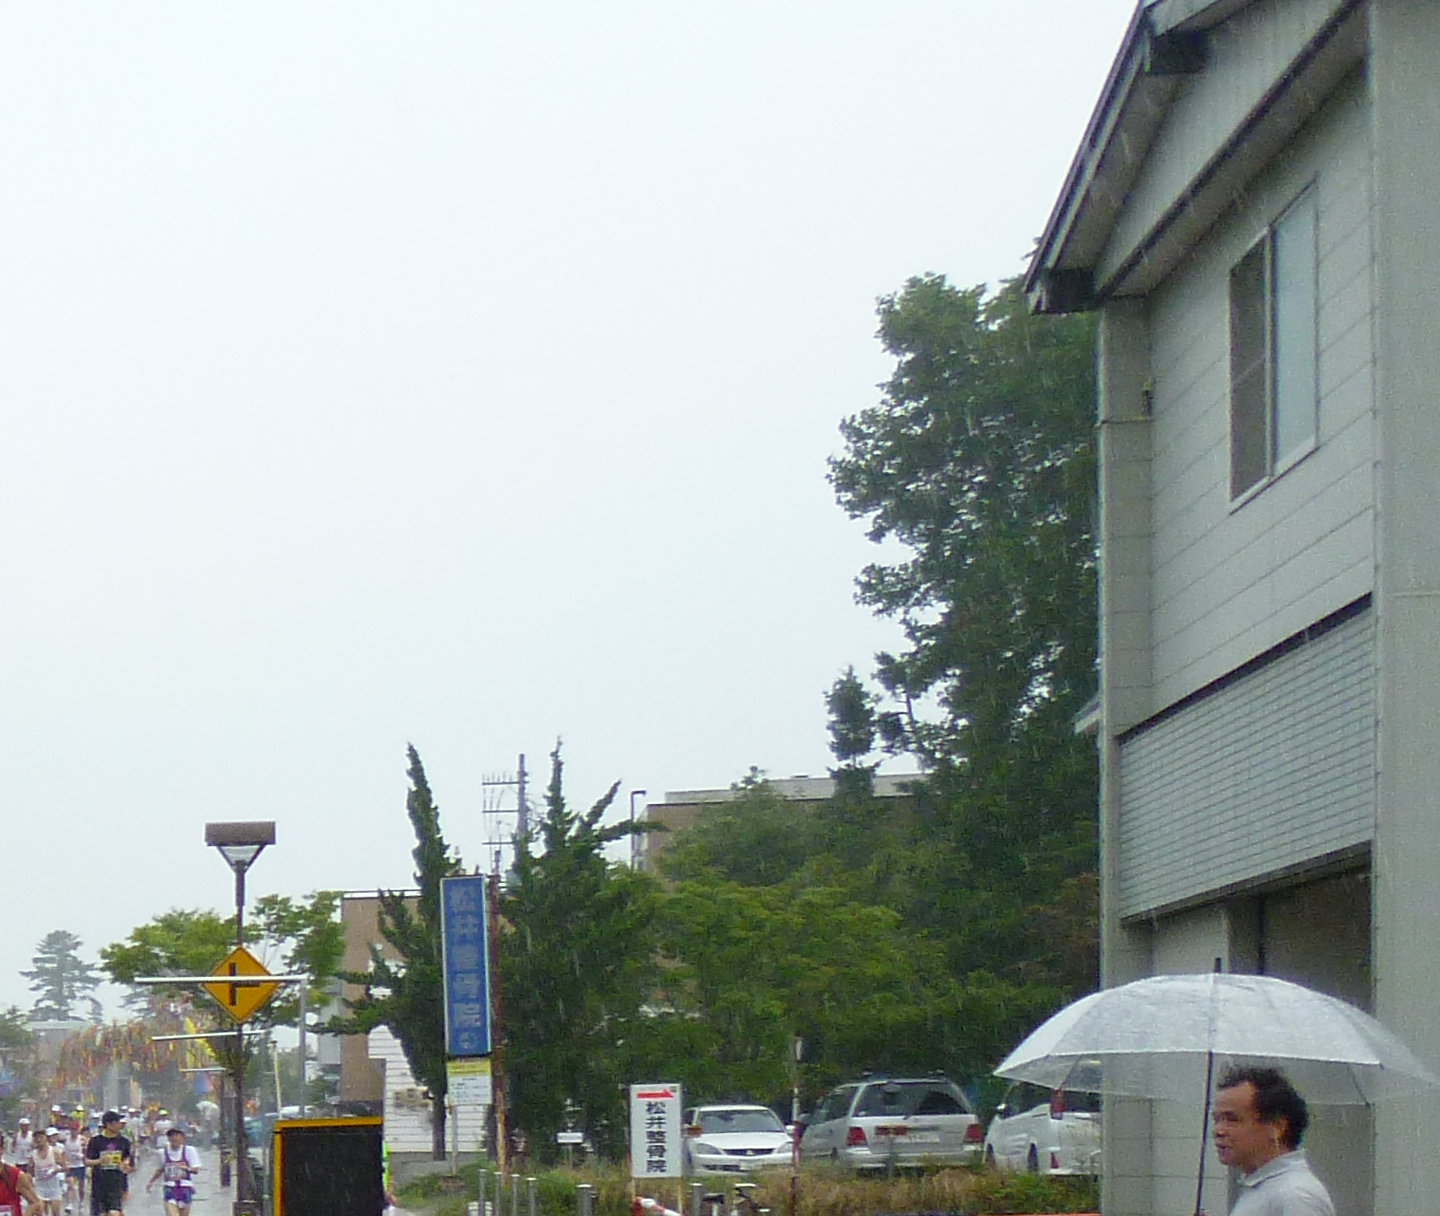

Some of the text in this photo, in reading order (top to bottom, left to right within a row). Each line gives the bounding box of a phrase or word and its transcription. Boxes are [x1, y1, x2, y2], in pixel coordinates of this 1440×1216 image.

[644, 1100, 668, 1174] 松井整骨院
